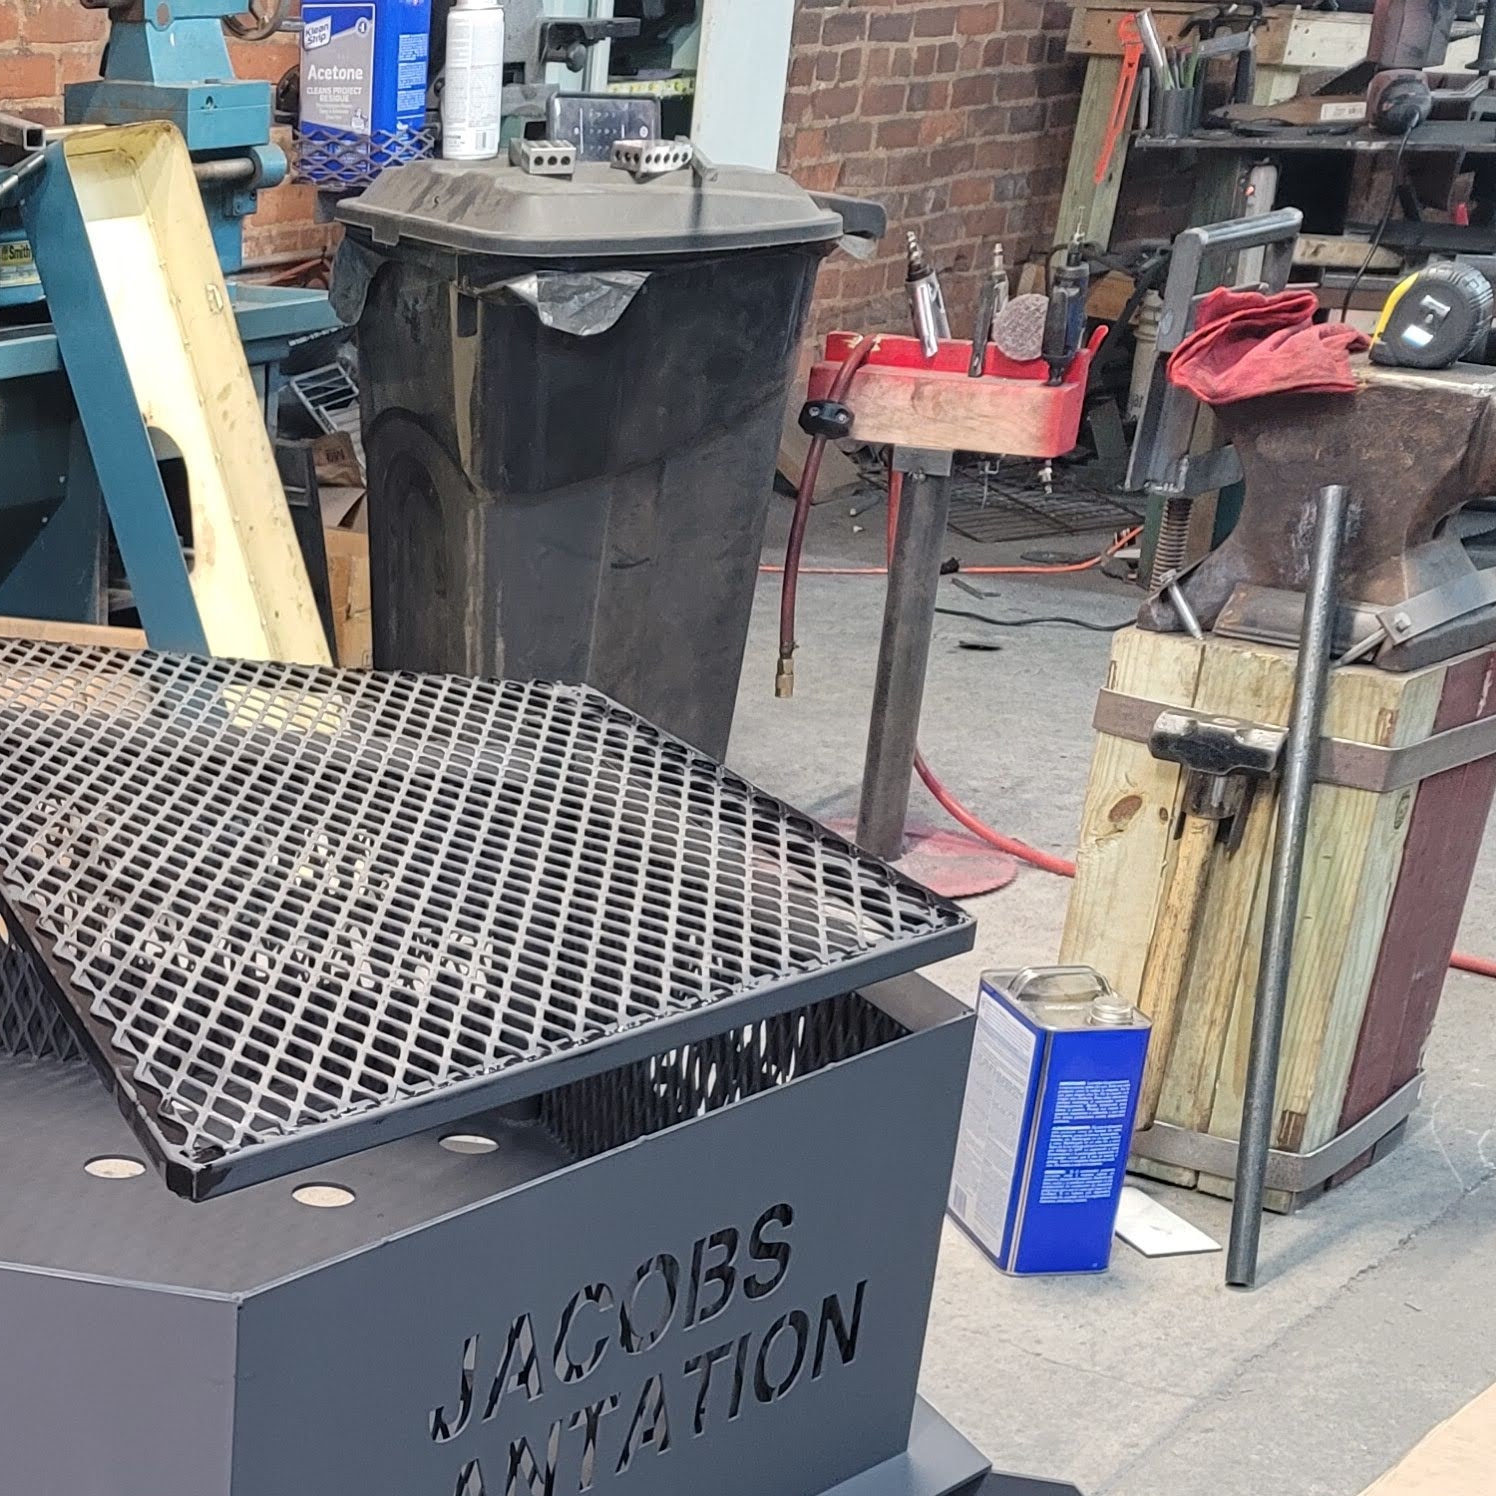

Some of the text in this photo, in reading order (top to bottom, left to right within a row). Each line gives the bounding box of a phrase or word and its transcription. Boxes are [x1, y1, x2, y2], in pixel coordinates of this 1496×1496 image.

[305, 24, 329, 37] Klean
[307, 33, 327, 45] Strip
[307, 64, 364, 81] Acetone
[8, 243, 32, 260] Smith
[428, 1202, 795, 1444] JACOBS
